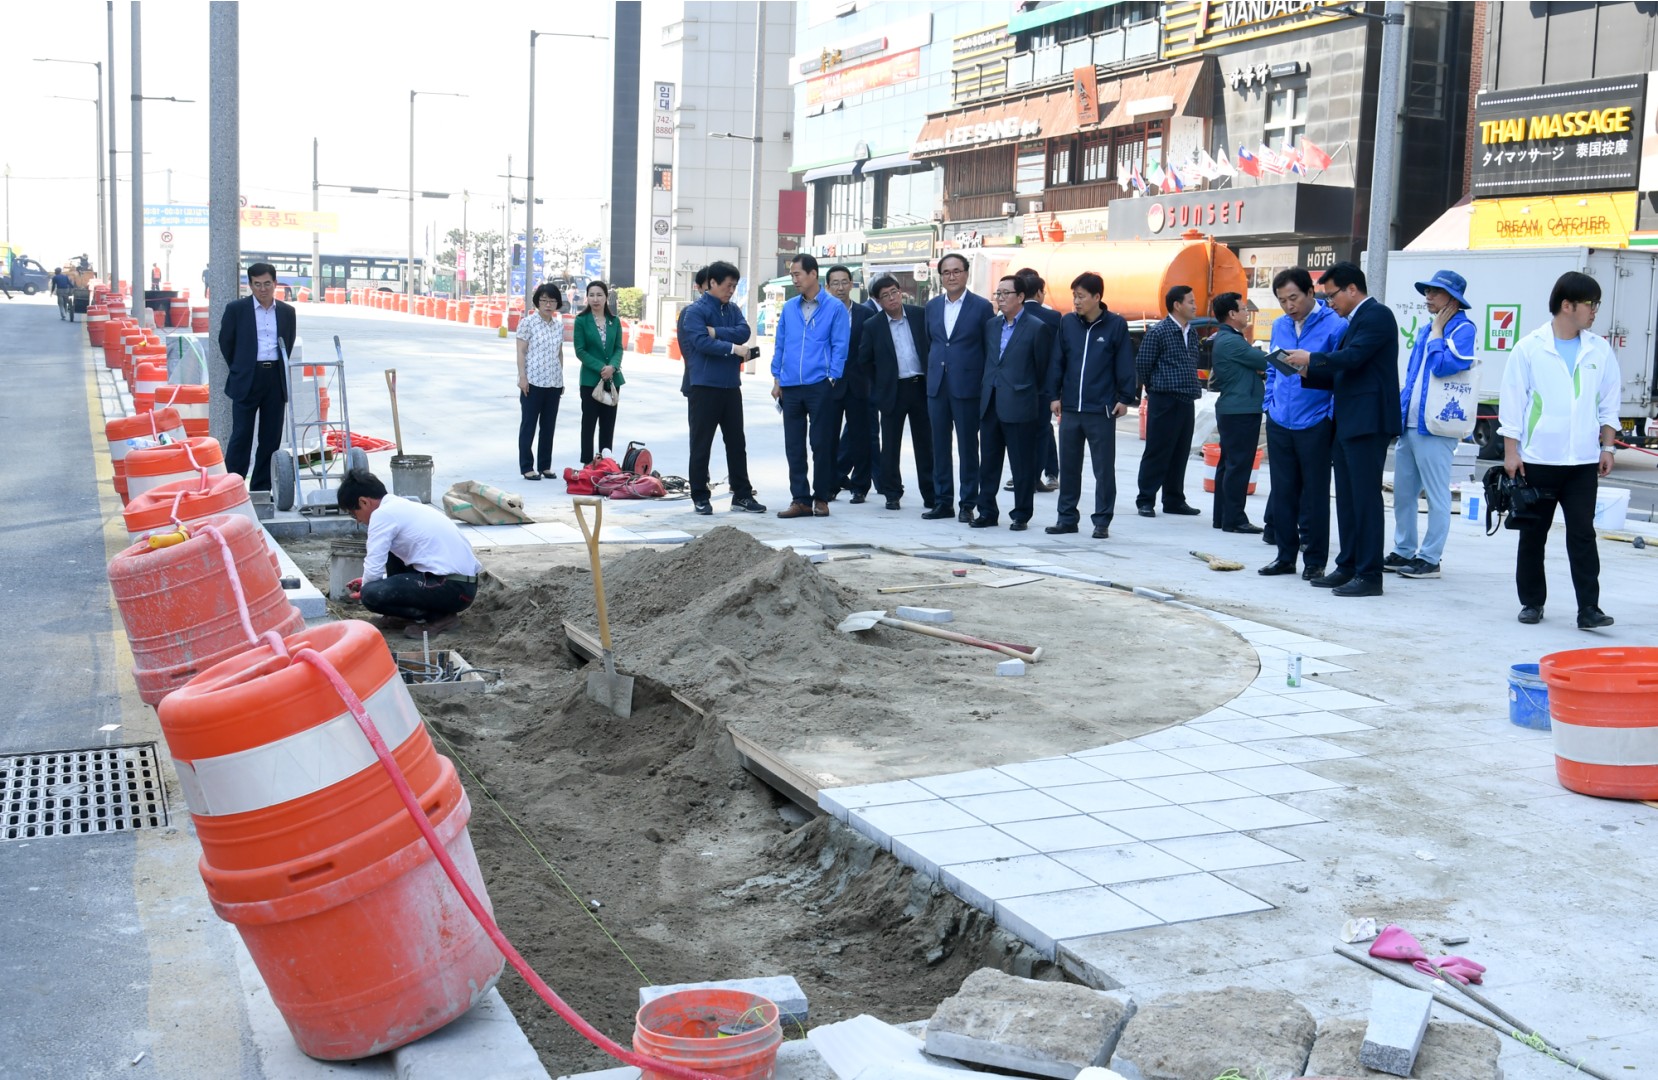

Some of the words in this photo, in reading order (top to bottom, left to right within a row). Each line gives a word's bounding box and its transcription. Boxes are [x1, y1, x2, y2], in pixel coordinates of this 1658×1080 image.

[659, 86, 670, 110] 임대
[1479, 116, 1526, 145] THAI
[1527, 106, 1632, 141] MASSAGE
[1482, 146, 1565, 167] タイマッサージ
[1575, 139, 1629, 159] 泰国按摩
[1167, 200, 1244, 228] SUNSET
[1496, 219, 1539, 233] DREAM
[1547, 216, 1606, 231] CATCHER
[1491, 329, 1513, 338] ELEVEN
